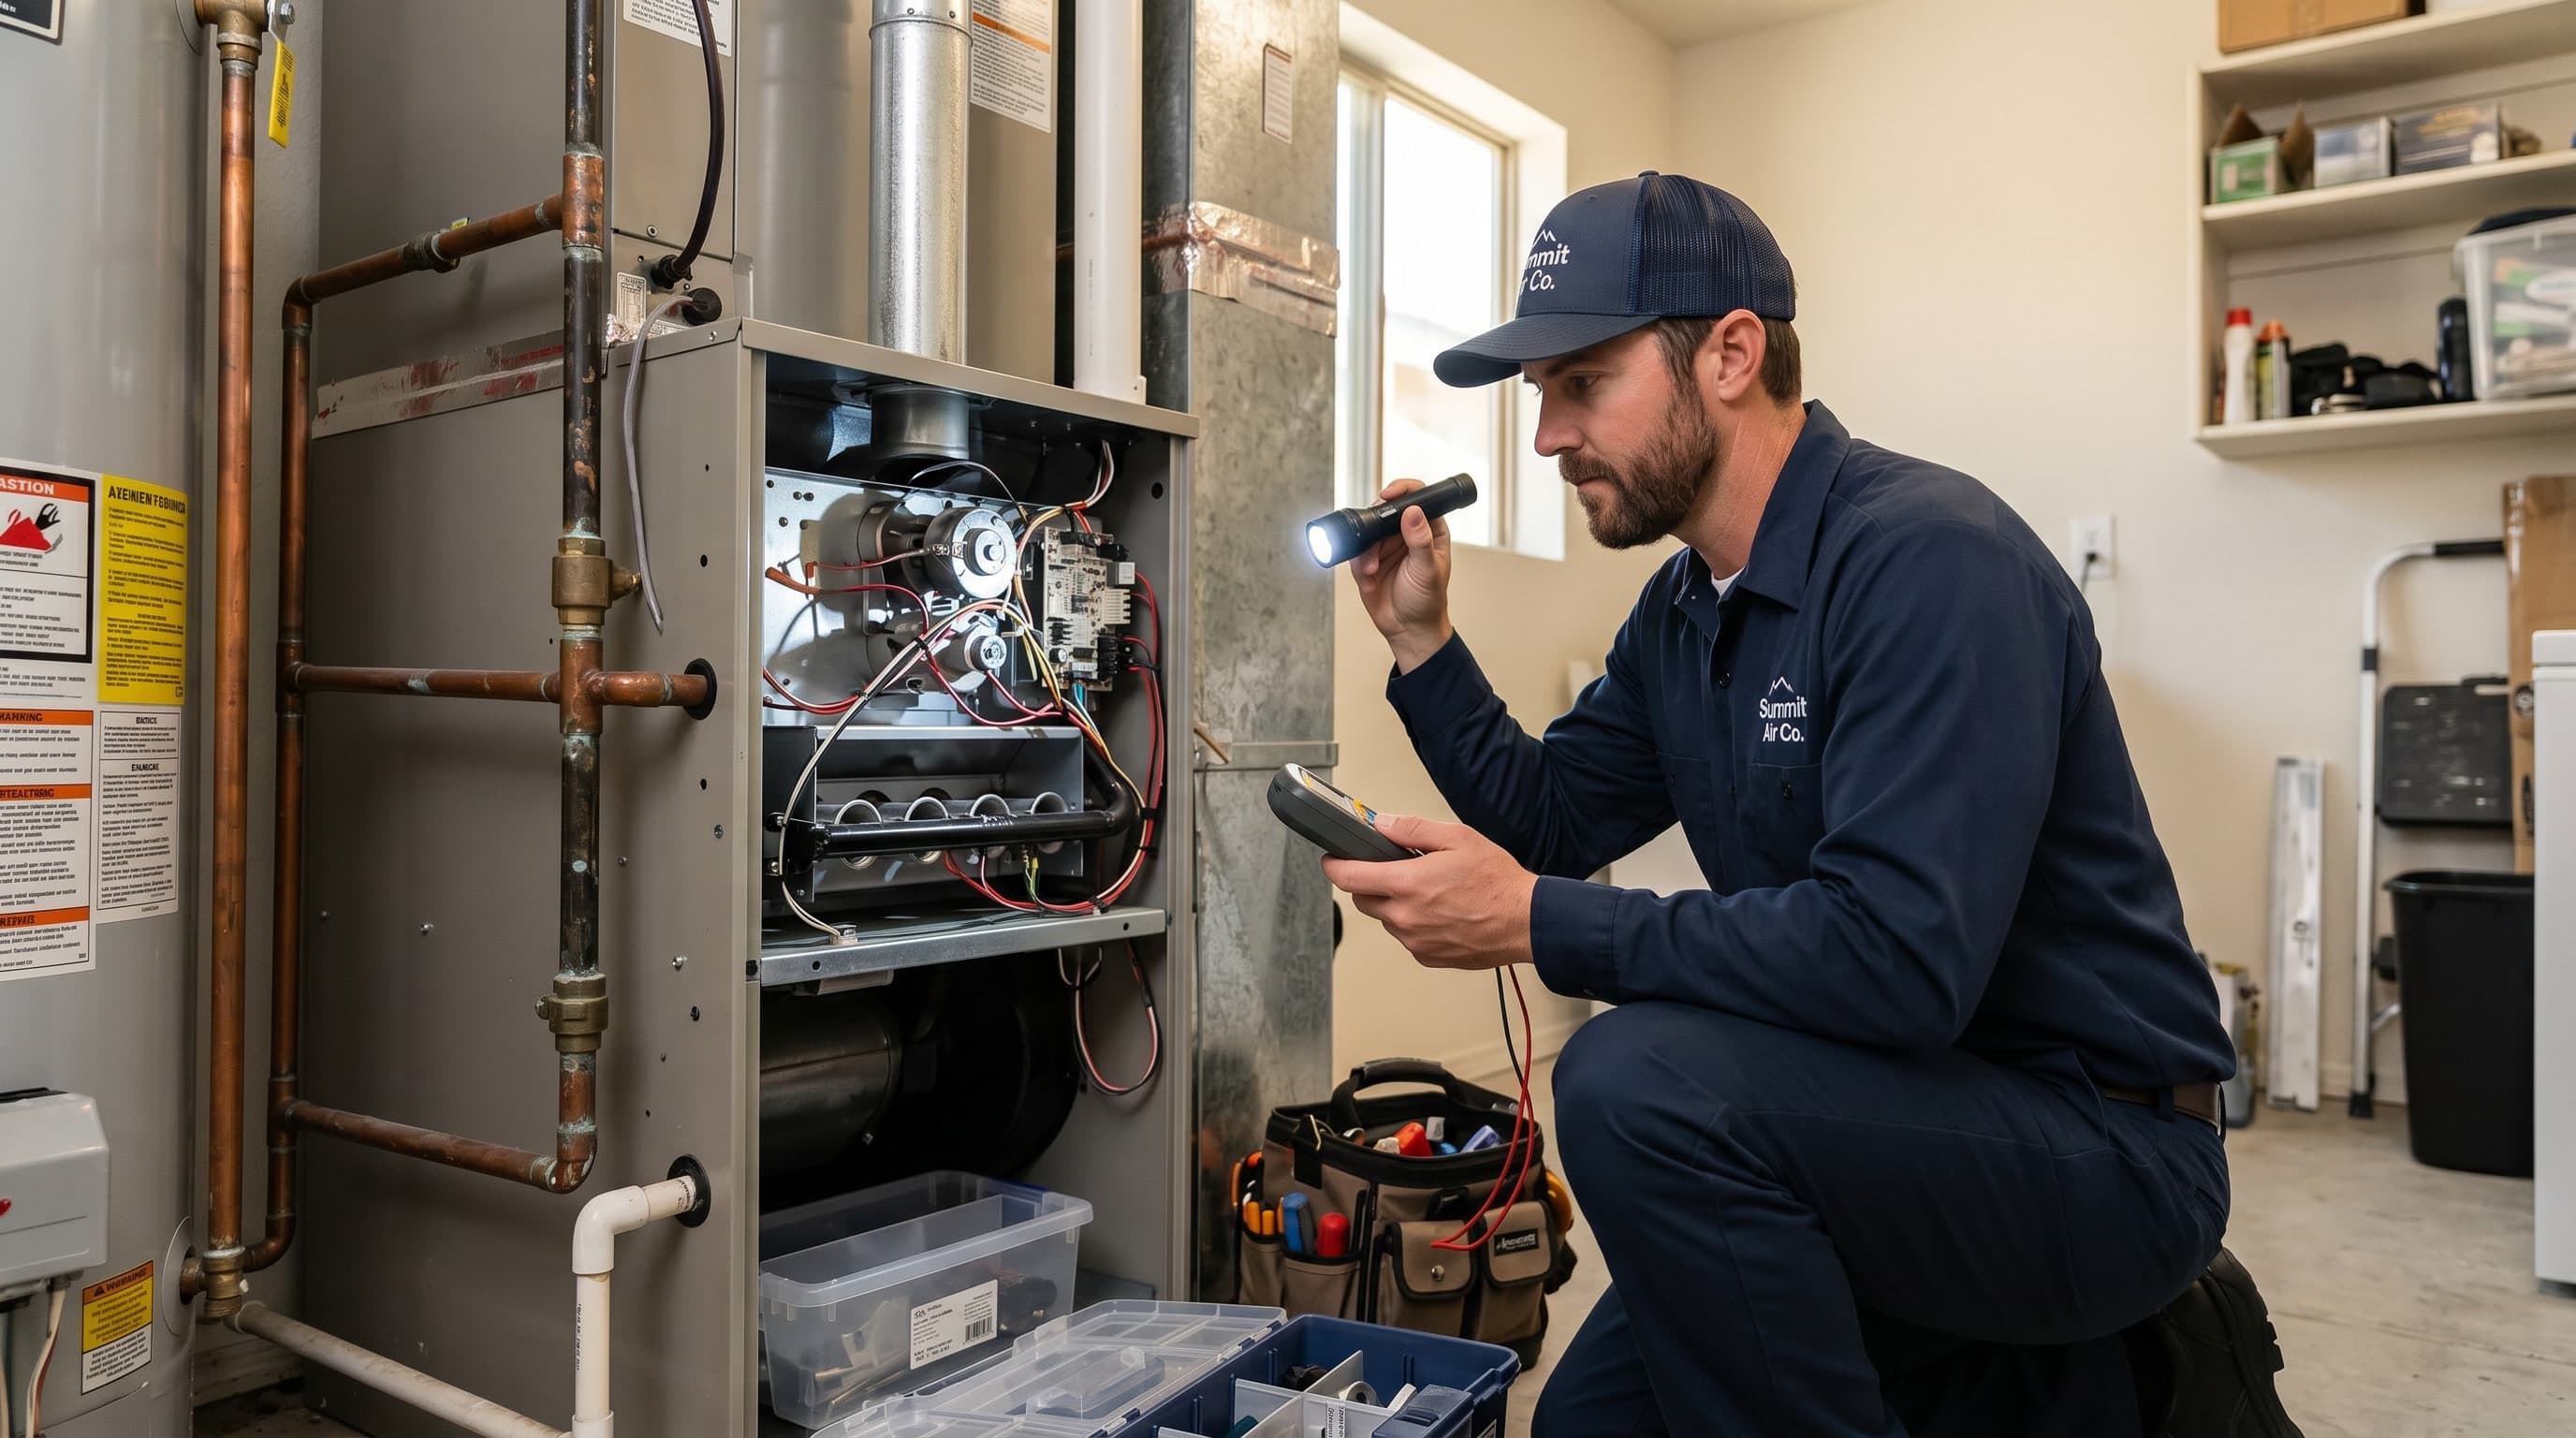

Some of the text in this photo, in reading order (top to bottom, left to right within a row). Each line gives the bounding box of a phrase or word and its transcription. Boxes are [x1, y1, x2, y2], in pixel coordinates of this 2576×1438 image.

[1525, 243, 1570, 270] mmit
[1530, 269, 1555, 291] Co.
[1760, 696, 1807, 719] Summit
[1763, 723, 1805, 741] Air Co.
